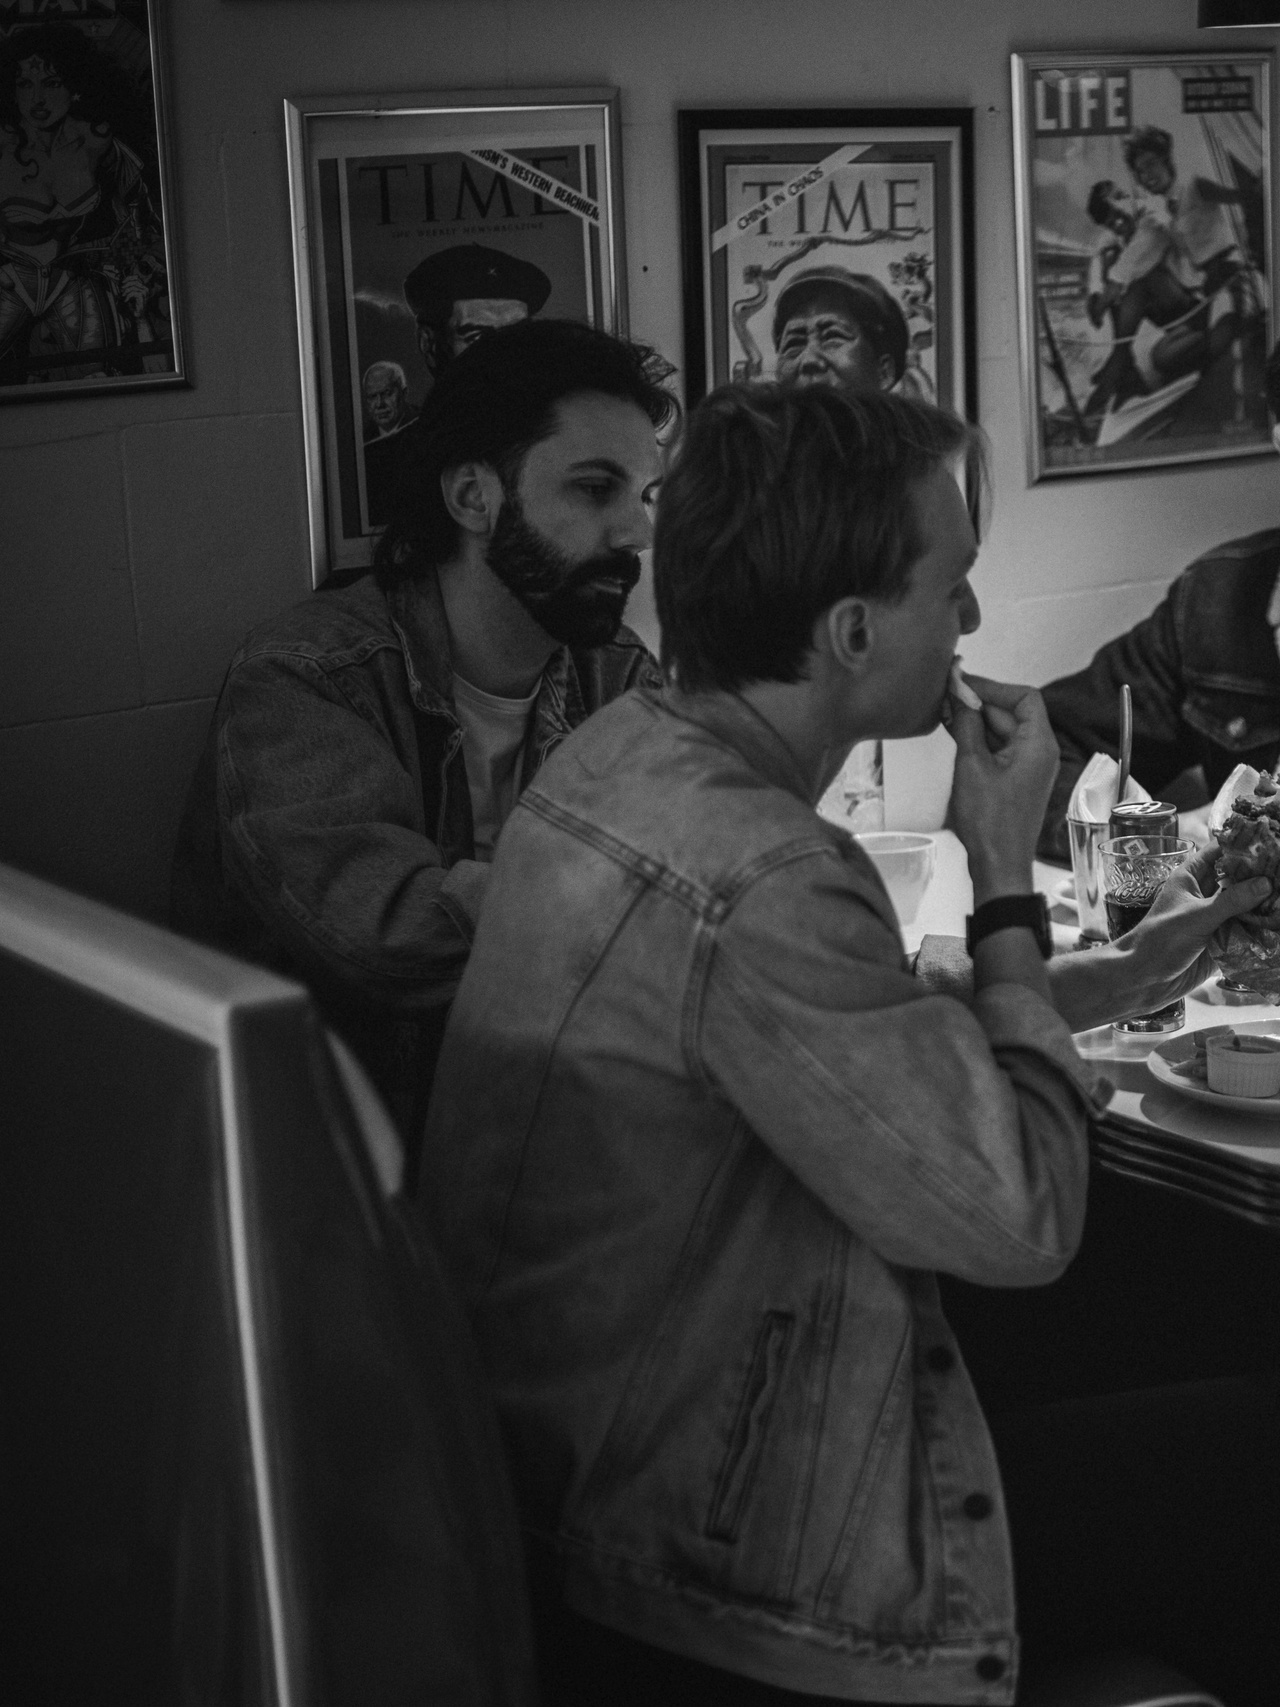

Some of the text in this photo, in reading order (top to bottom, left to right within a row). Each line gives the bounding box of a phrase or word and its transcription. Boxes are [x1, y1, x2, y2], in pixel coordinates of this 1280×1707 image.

[1034, 76, 1128, 131] LIFE
[358, 155, 569, 226] TIME
[510, 162, 553, 194] WESTERN
[737, 166, 824, 230] CHINA IN CHAOS
[742, 178, 920, 235] TIME
